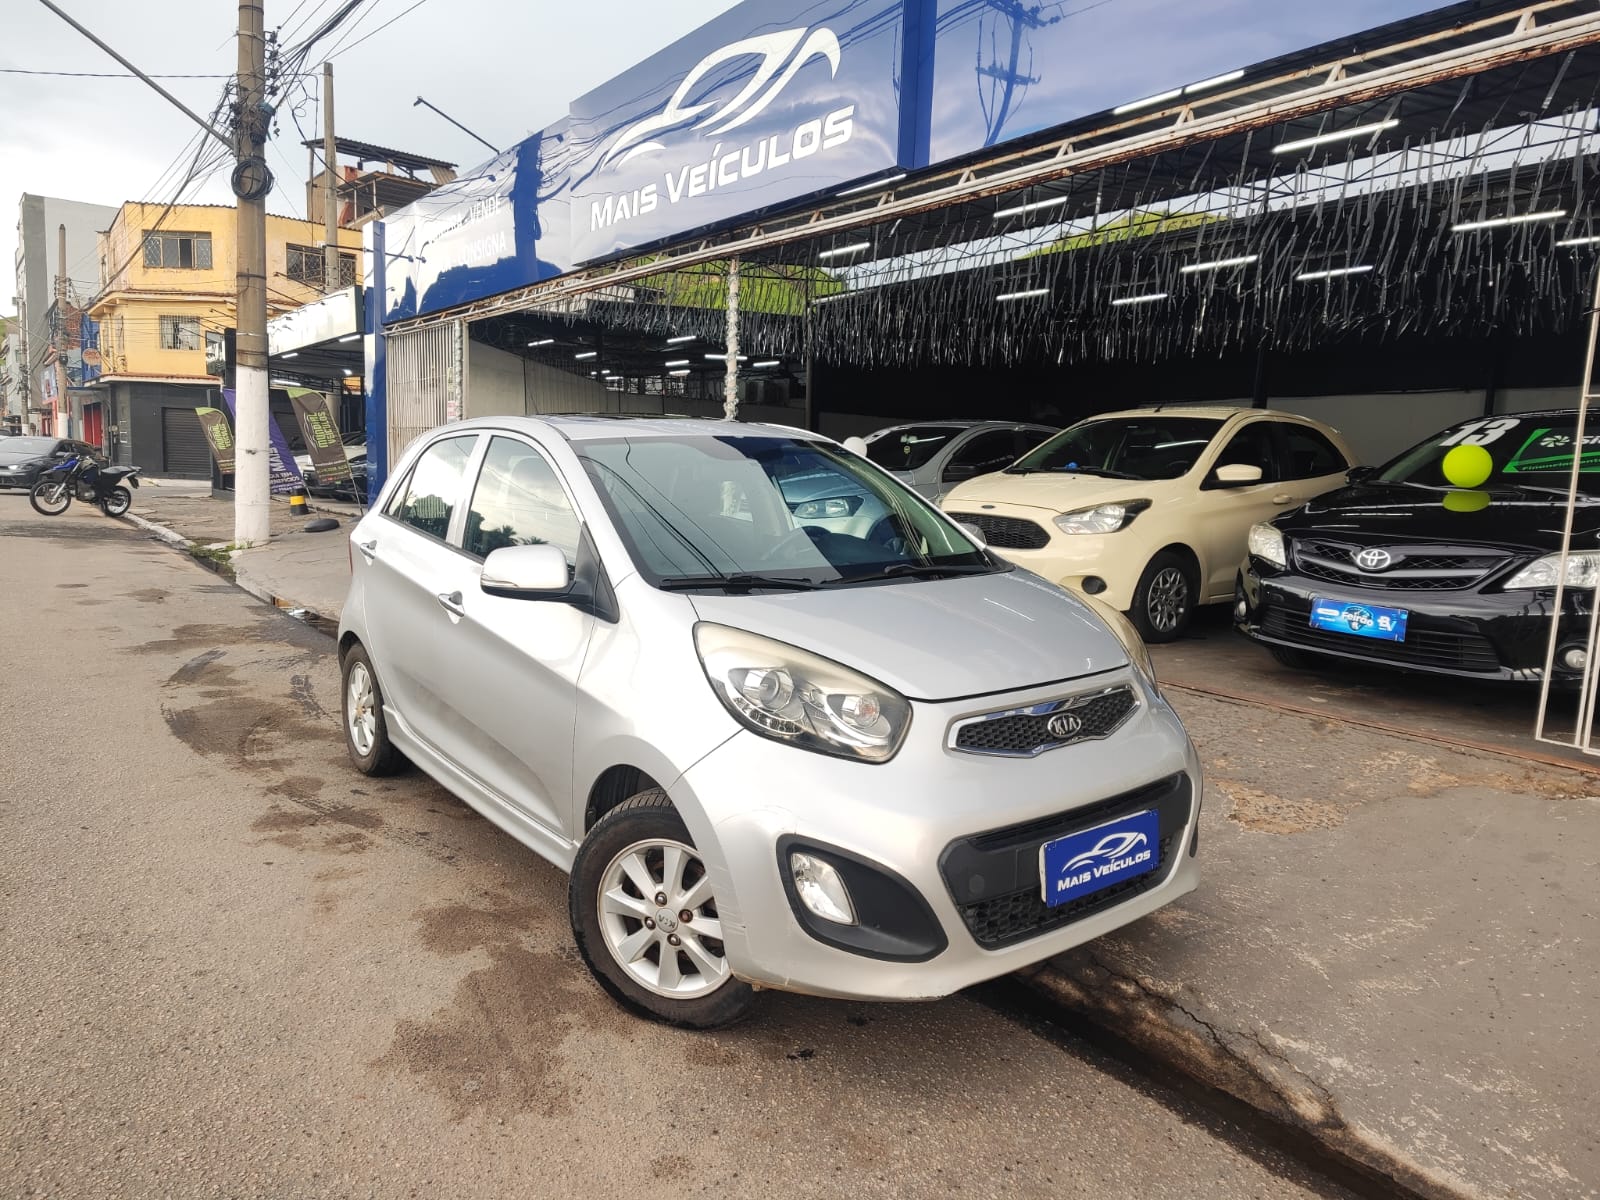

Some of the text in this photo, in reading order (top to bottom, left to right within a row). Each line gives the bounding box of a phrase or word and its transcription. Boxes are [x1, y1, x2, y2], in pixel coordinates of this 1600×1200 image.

[590, 105, 855, 232] MAIS VEÍCULOS
[1093, 850, 1151, 878] VEÍCULOS
[1057, 871, 1091, 891] MAIS
